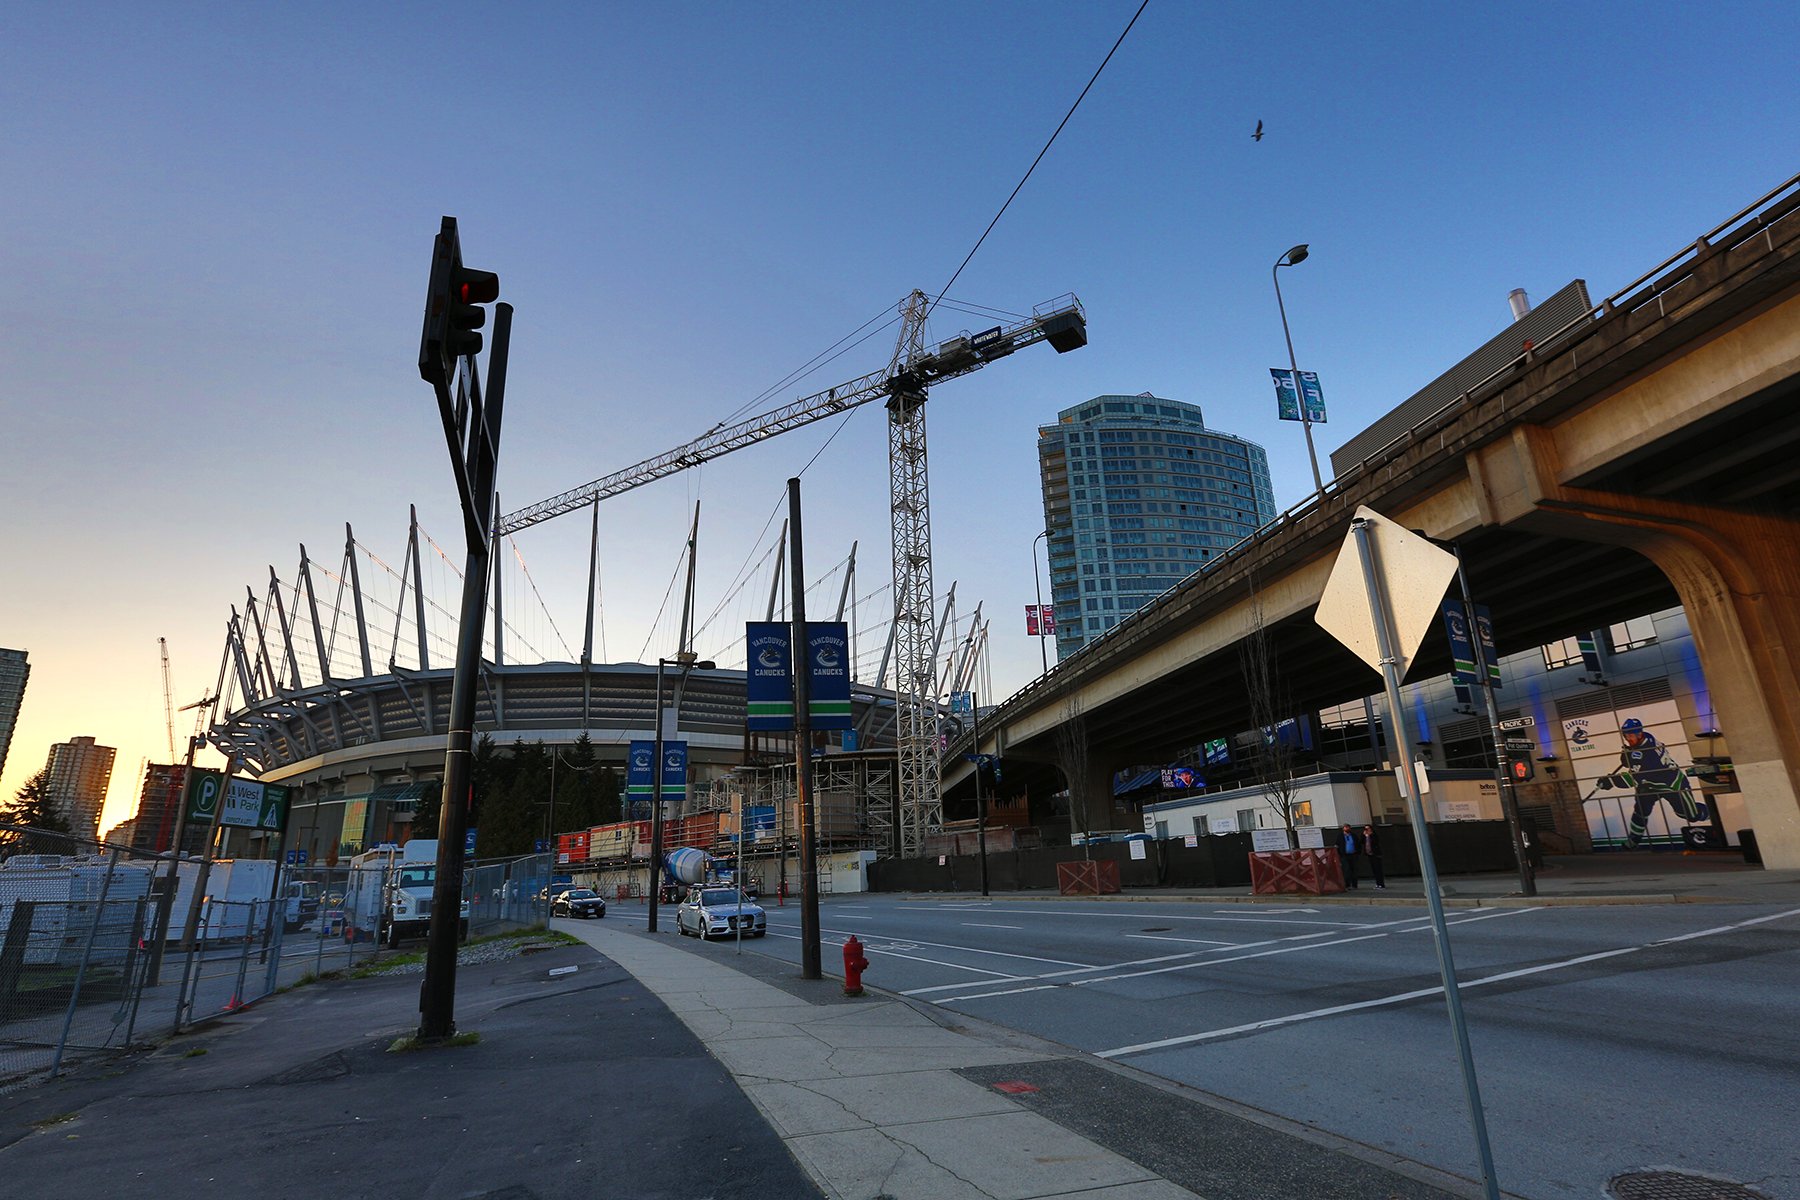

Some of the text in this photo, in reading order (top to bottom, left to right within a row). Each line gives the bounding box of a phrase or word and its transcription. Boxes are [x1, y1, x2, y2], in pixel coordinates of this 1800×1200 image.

[752, 636, 787, 648] VANCOUVER
[809, 636, 845, 648] VANCOUVER
[754, 668, 786, 677] CANUCKS
[813, 668, 844, 676] CANUCKS
[1504, 719, 1522, 728] PACIFIC
[1565, 719, 1590, 730] CANUCKS
[200, 781, 215, 805] P
[237, 786, 260, 800] West
[240, 798, 259, 812] Park
